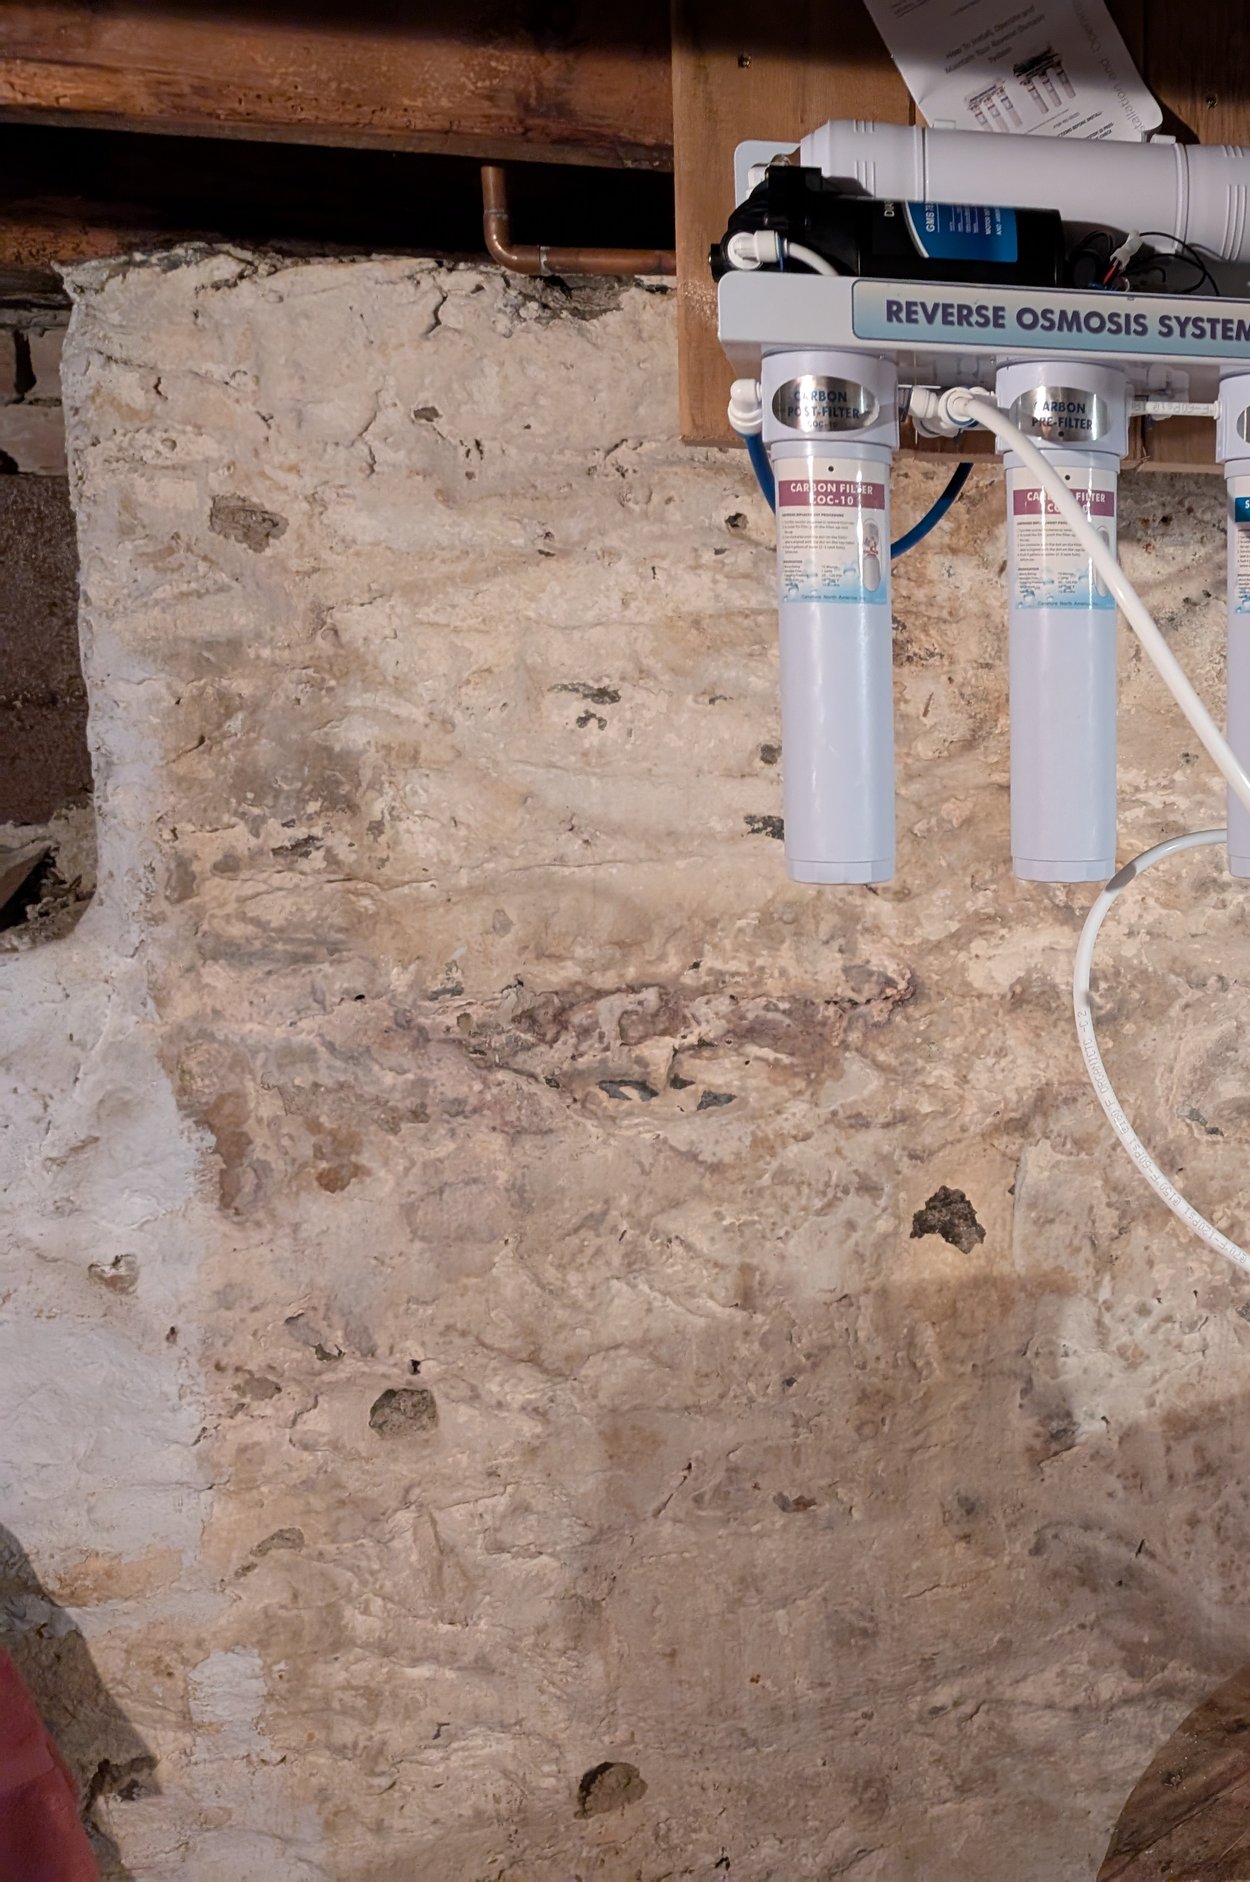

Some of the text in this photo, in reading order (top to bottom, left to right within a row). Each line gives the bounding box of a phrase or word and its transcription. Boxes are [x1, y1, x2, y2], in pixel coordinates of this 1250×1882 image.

[886, 299, 1006, 329] REVERSE
[1015, 308, 1149, 336] OSMOSIS
[787, 406, 860, 419] POST-FILTER
[1034, 401, 1086, 414] ARBON
[1032, 418, 1092, 431] PRE-FILTER
[790, 482, 837, 493] CARBON
[811, 495, 854, 505] COC-10
[1075, 492, 1106, 503] FILTER
